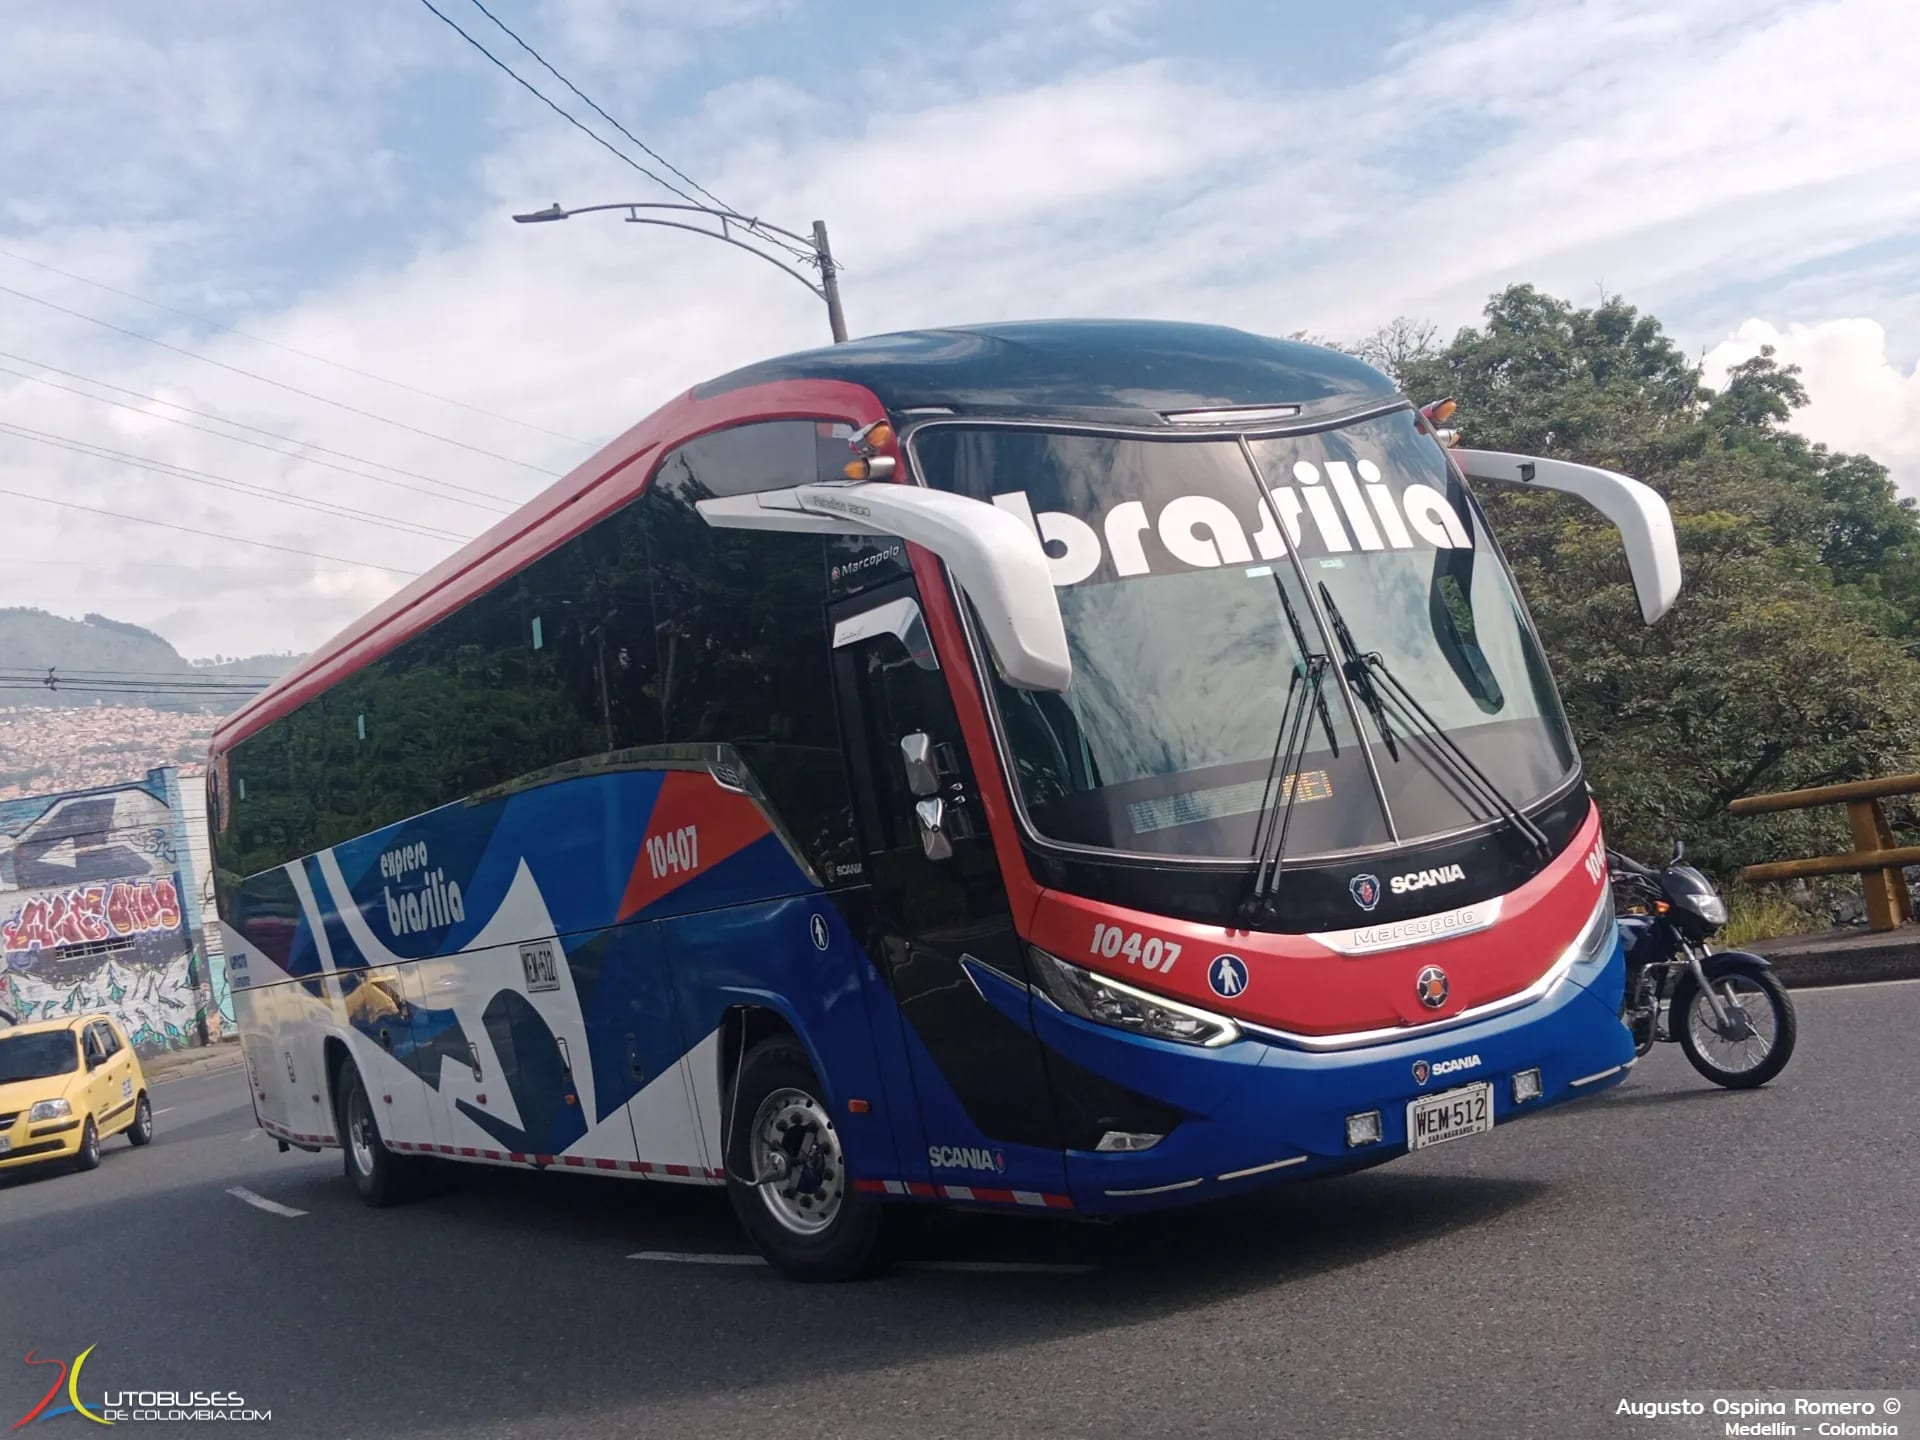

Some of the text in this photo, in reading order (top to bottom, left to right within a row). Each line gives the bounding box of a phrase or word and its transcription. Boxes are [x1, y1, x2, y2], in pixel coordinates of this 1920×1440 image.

[992, 459, 1473, 586] brasilia
[841, 545, 899, 577] Marcopolo
[380, 840, 428, 882] expreso
[647, 825, 698, 879] 10407
[1390, 864, 1465, 894] SCANIA
[384, 867, 465, 937] brasilia
[1353, 910, 1475, 946] Marcopolo
[1090, 923, 1182, 974] 10407
[1432, 1054, 1482, 1077] SCANIA
[1417, 1097, 1485, 1137] WEM 512
[929, 1146, 995, 1171] SCANIA
